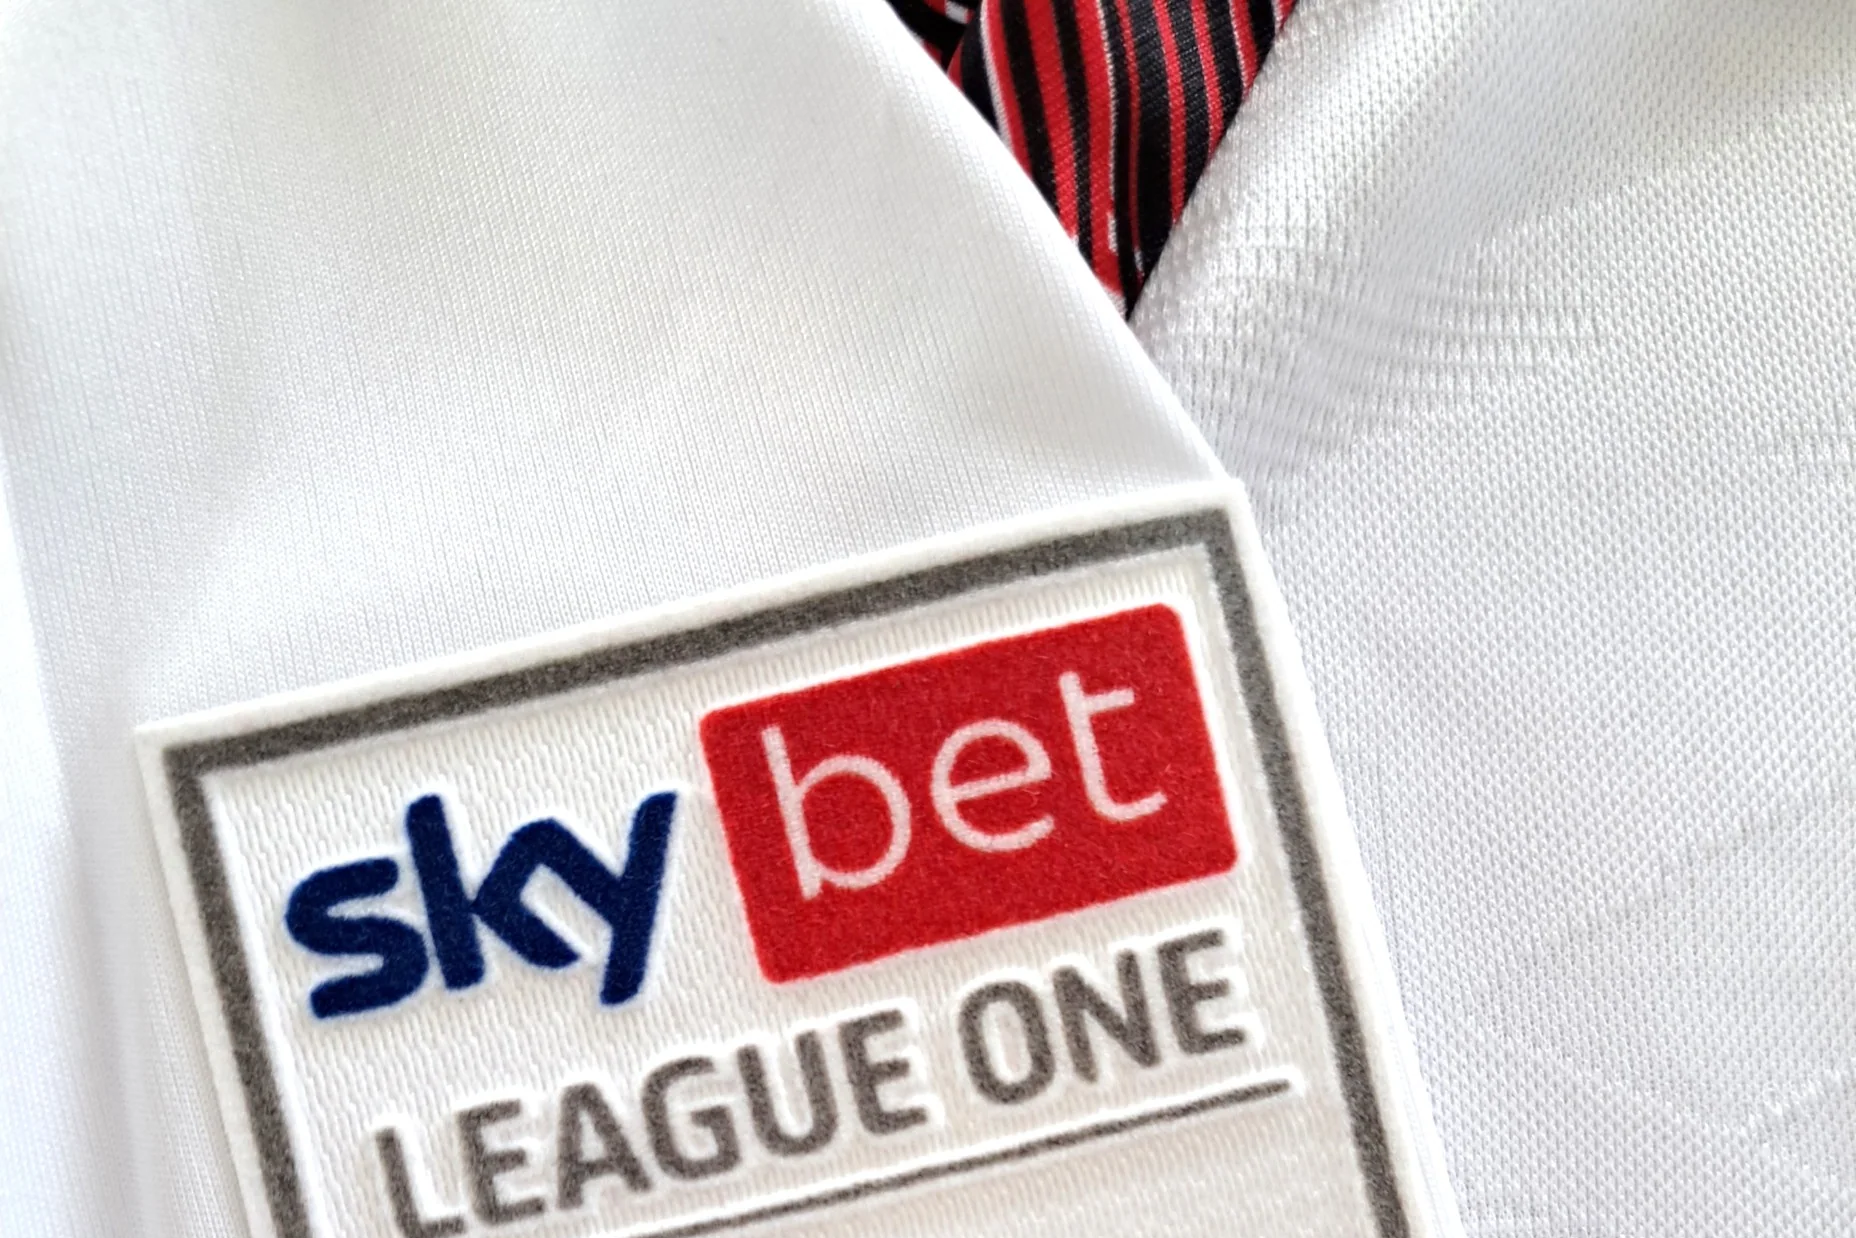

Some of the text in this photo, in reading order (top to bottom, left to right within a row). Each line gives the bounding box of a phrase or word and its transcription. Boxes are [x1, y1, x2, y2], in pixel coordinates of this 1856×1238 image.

[285, 670, 1167, 1018] sky bet
[959, 930, 1246, 1104] ONE
